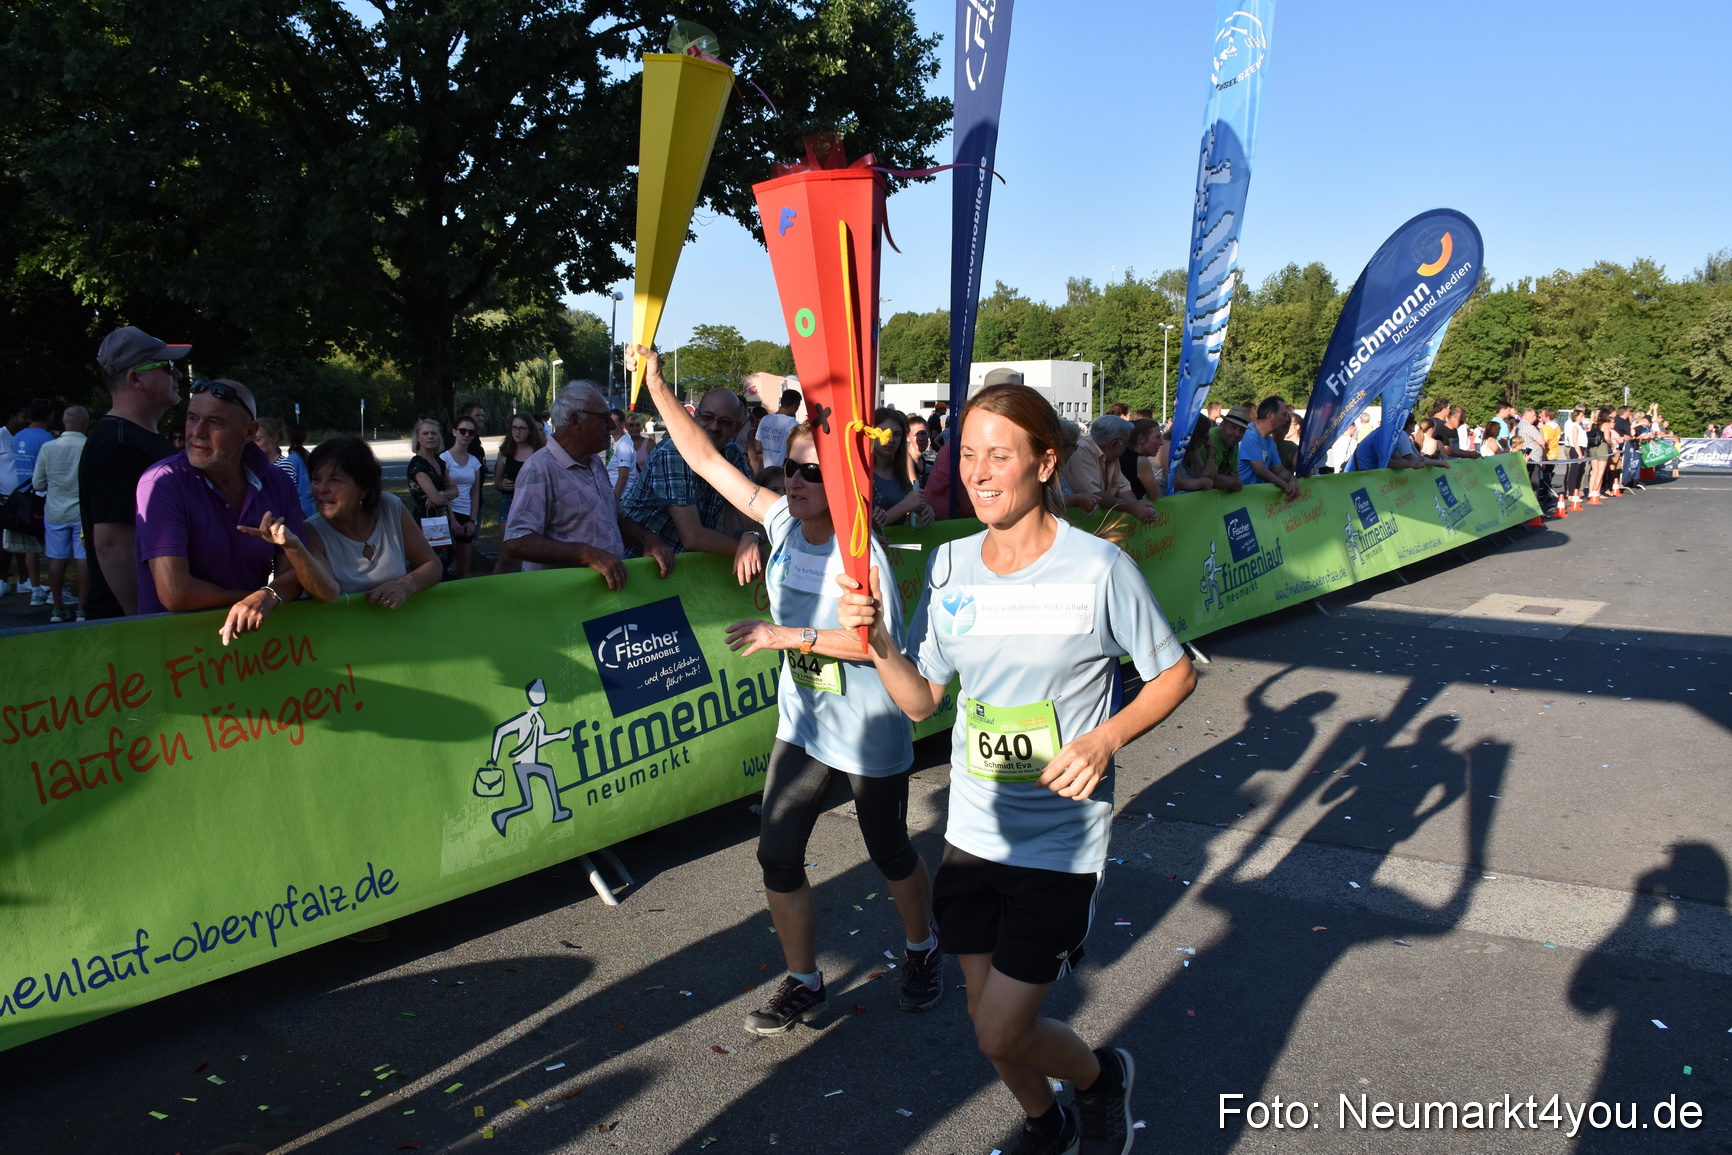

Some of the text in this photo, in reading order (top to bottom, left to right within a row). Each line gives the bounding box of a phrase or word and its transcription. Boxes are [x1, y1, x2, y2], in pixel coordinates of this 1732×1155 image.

[1391, 261, 1472, 345] Druck und Medien
[1325, 282, 1431, 396] Frischmann
[1232, 523, 1250, 537] Fischer
[1222, 537, 1283, 591] firmenlauf
[1226, 582, 1258, 603] neumarkt
[1001, 602, 1038, 613] katholische
[1043, 602, 1089, 612] Volksschule
[615, 630, 679, 662] Fischer
[626, 645, 681, 670] AUTOMOBILE
[165, 634, 318, 699] Firmen
[644, 672, 659, 686] und
[659, 667, 674, 677] das
[685, 664, 701, 679] mit!
[788, 650, 822, 676] 644
[31, 664, 365, 804] laufen länger!
[978, 731, 1033, 761] 640
[587, 746, 691, 806] neumarkt
[984, 760, 1032, 770] Schmidt Eva
